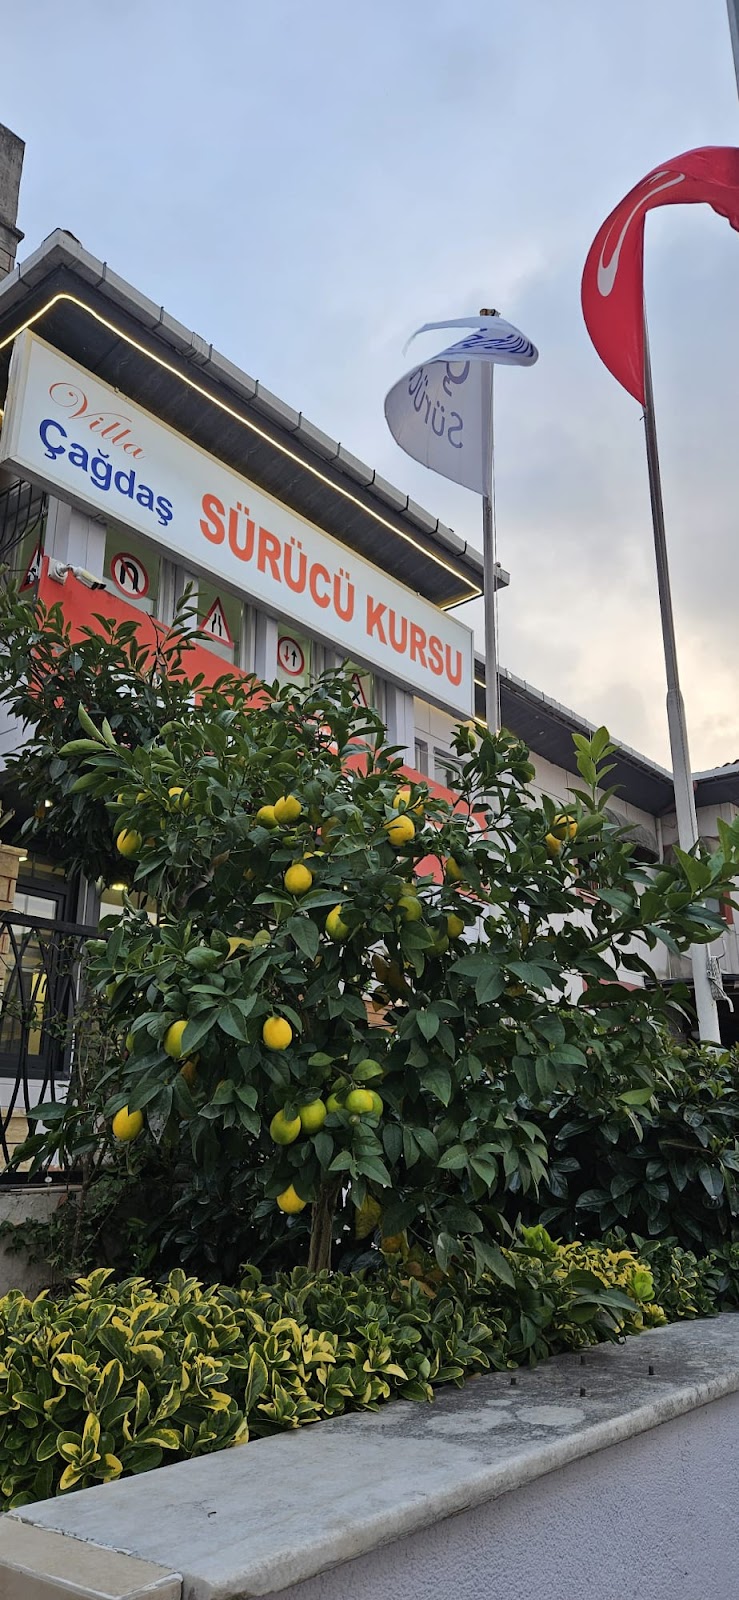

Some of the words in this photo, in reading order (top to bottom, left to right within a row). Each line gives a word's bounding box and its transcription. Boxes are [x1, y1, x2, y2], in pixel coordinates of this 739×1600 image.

[38, 417, 175, 528] Çağdaş
[48, 380, 146, 461] Villa
[199, 493, 356, 622] SÜRÜCÜ
[365, 595, 463, 687] KURSU
